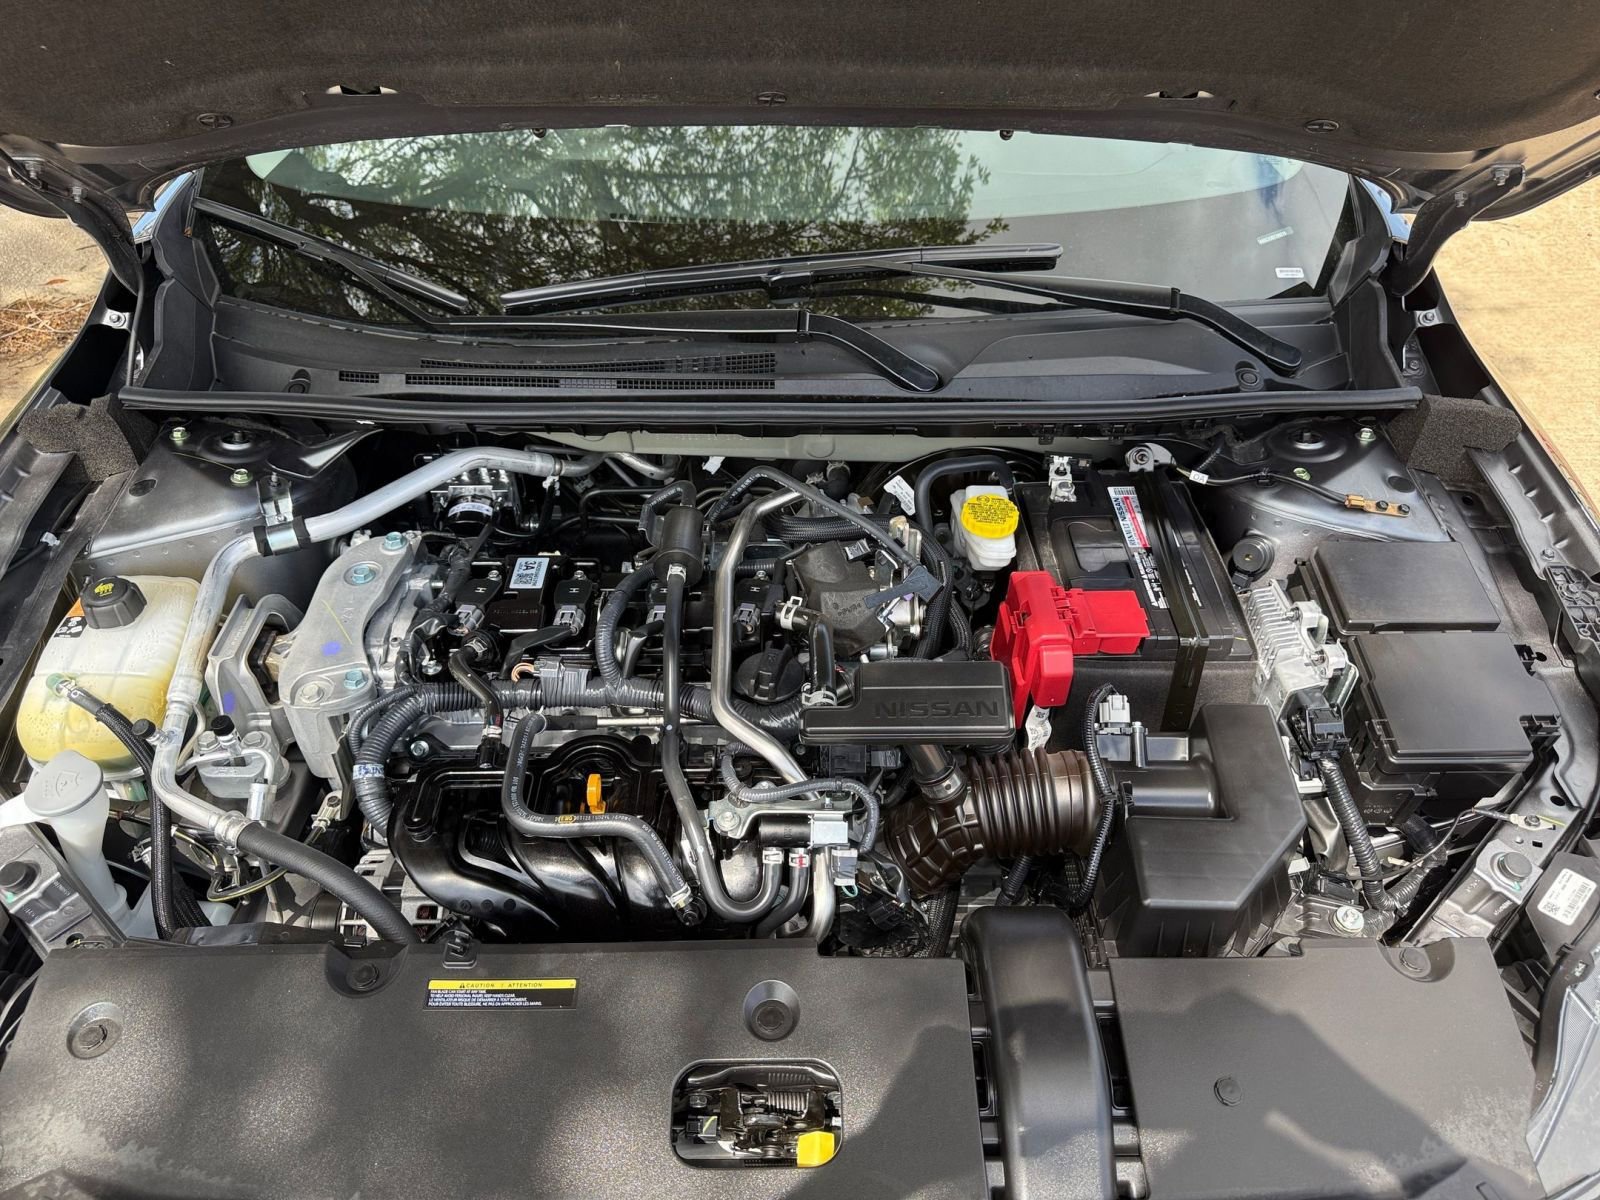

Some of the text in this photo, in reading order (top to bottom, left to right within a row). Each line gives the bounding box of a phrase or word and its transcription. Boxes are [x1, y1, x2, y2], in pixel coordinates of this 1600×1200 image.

[1113, 497, 1127, 522] NISSAN
[522, 560, 537, 571] 3A
[874, 700, 999, 719] NISSAN
